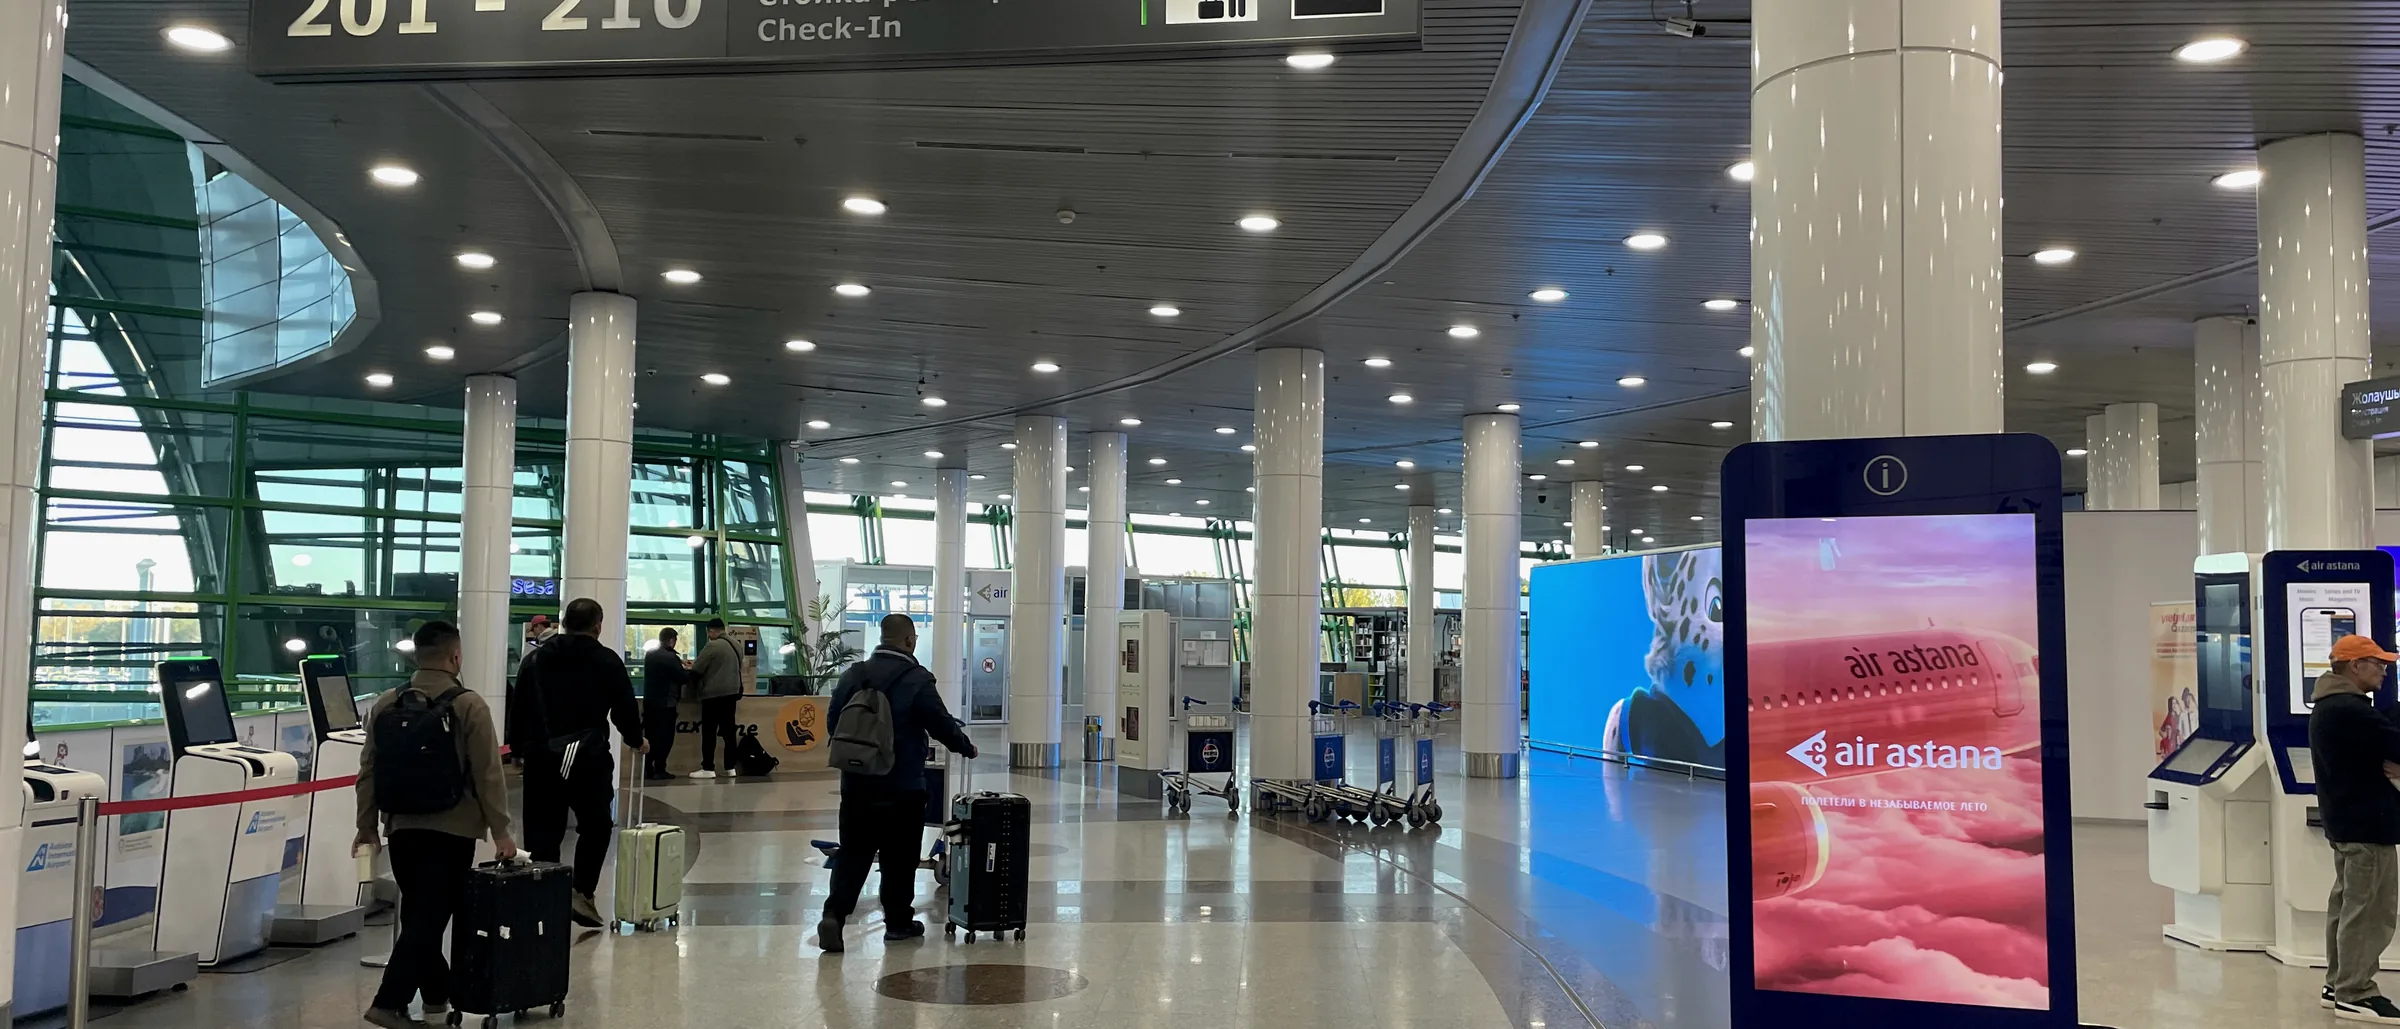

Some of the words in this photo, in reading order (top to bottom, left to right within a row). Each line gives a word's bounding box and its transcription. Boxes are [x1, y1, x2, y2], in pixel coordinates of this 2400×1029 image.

[287, 0, 437, 37] 201
[757, 16, 901, 42] Check-In
[2310, 560, 2325, 570] air
[2326, 561, 2360, 571] astana
[993, 586, 1008, 599] air
[1844, 646, 1884, 679] air
[1888, 643, 1980, 675] astana
[1835, 735, 1880, 767] air
[1886, 740, 2003, 771] astana
[1801, 796, 1856, 807] ПОЛЕТЕЛИ
[1859, 798, 1867, 808] В
[1870, 799, 1956, 811] НЕЗАБЫВАЕМОЕ
[1960, 802, 1988, 812] ЛЕТО
